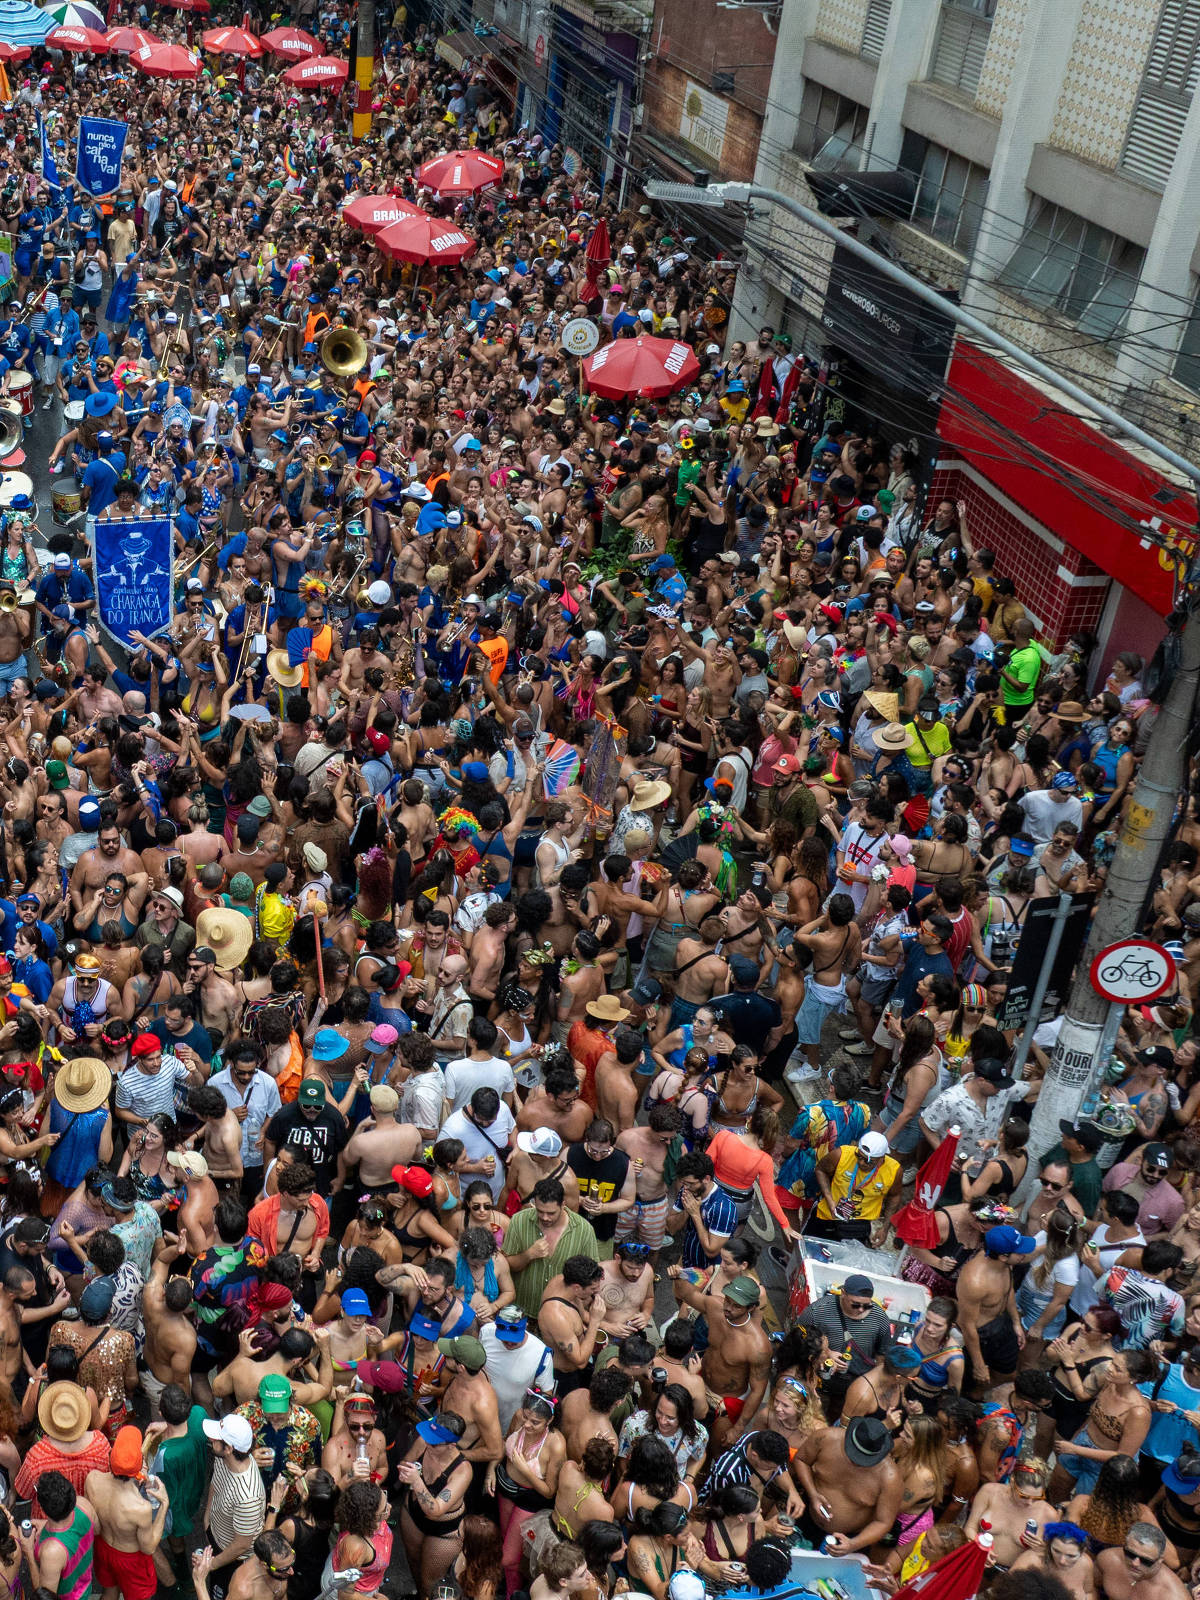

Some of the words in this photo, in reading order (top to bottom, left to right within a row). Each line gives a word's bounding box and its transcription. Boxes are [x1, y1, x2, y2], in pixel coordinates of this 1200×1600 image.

[282, 39, 313, 53] BRAHMA
[301, 65, 337, 78] BRAHMA
[87, 132, 115, 143] nunca
[100, 163, 118, 175] val
[373, 209, 417, 222] BRAH
[430, 232, 469, 252] BRAHMA
[663, 342, 690, 376] BRA
[111, 594, 161, 609] CHARANGA
[107, 609, 124, 625] DO
[521, 1066, 537, 1082] 2
